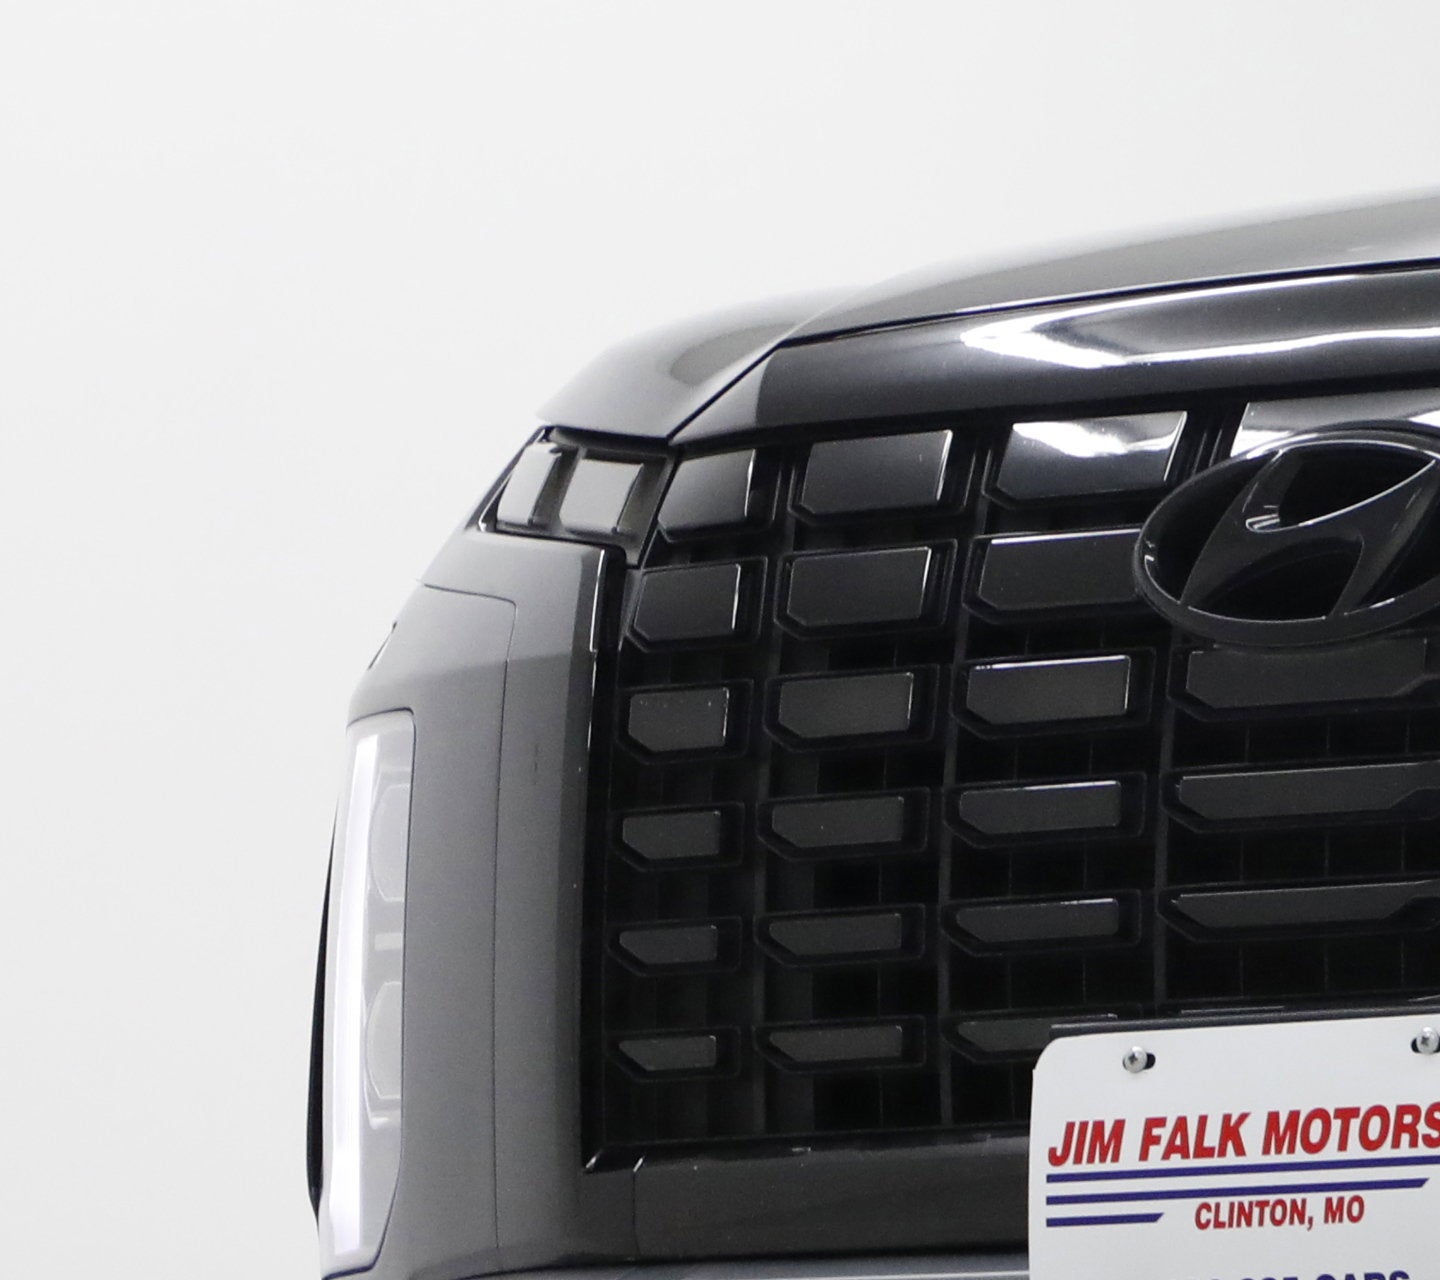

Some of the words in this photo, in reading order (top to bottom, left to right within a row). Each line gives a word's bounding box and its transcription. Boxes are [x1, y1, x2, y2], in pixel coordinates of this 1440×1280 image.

[1048, 1119, 1126, 1167] JIM
[1139, 1112, 1251, 1162] FALK
[1195, 1198, 1313, 1231] CLINTON,
[1324, 1195, 1365, 1224] MO
